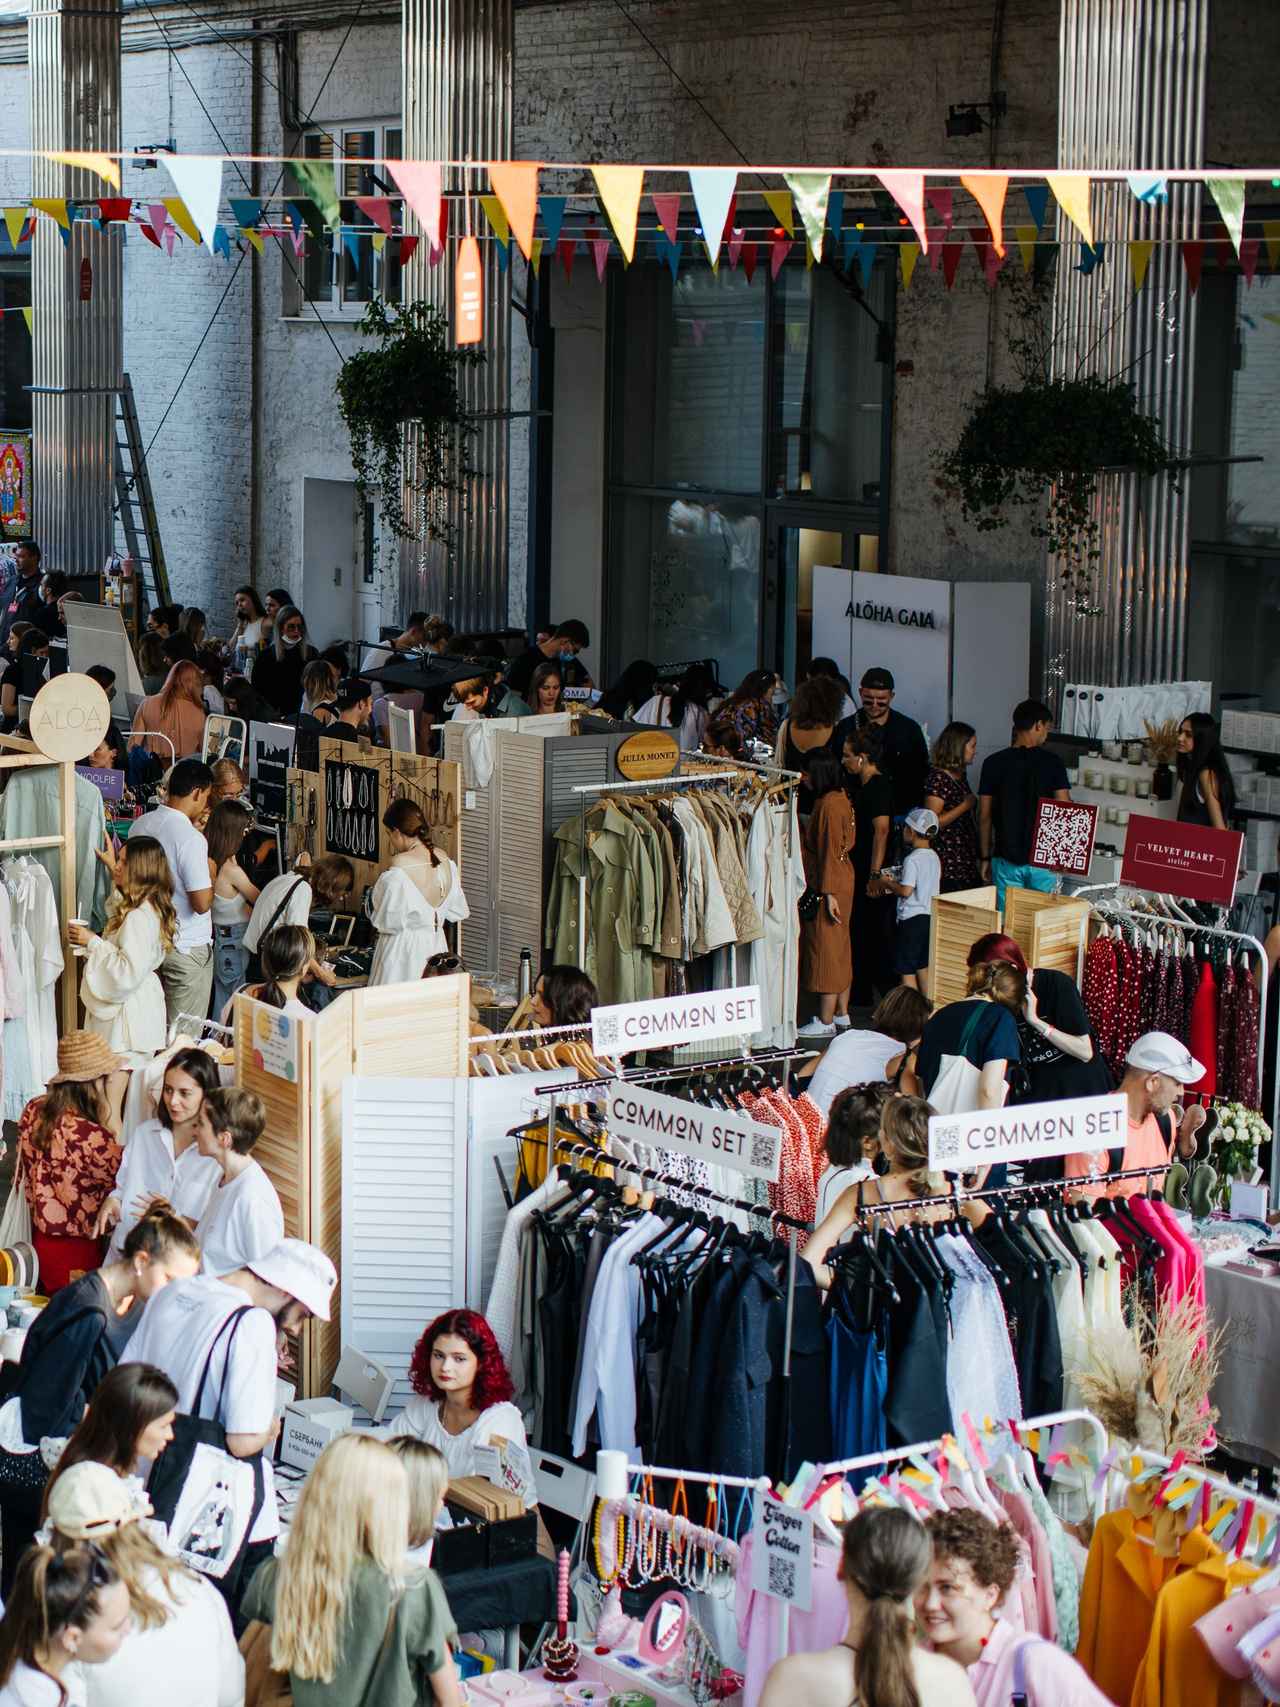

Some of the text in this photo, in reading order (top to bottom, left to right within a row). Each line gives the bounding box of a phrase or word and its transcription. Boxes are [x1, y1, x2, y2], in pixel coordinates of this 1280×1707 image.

[898, 608, 935, 629] GAIA
[621, 751, 676, 763] JULIA MONET
[1147, 843, 1214, 862] VELVET HEART
[1167, 857, 1190, 867] atelier
[724, 998, 756, 1022] SET
[1085, 1109, 1122, 1135] SET
[711, 1126, 746, 1156] SET
[289, 1429, 324, 1450] СБЕРБАНК
[762, 1500, 803, 1531] Ginger
[765, 1528, 801, 1554] Cotton
